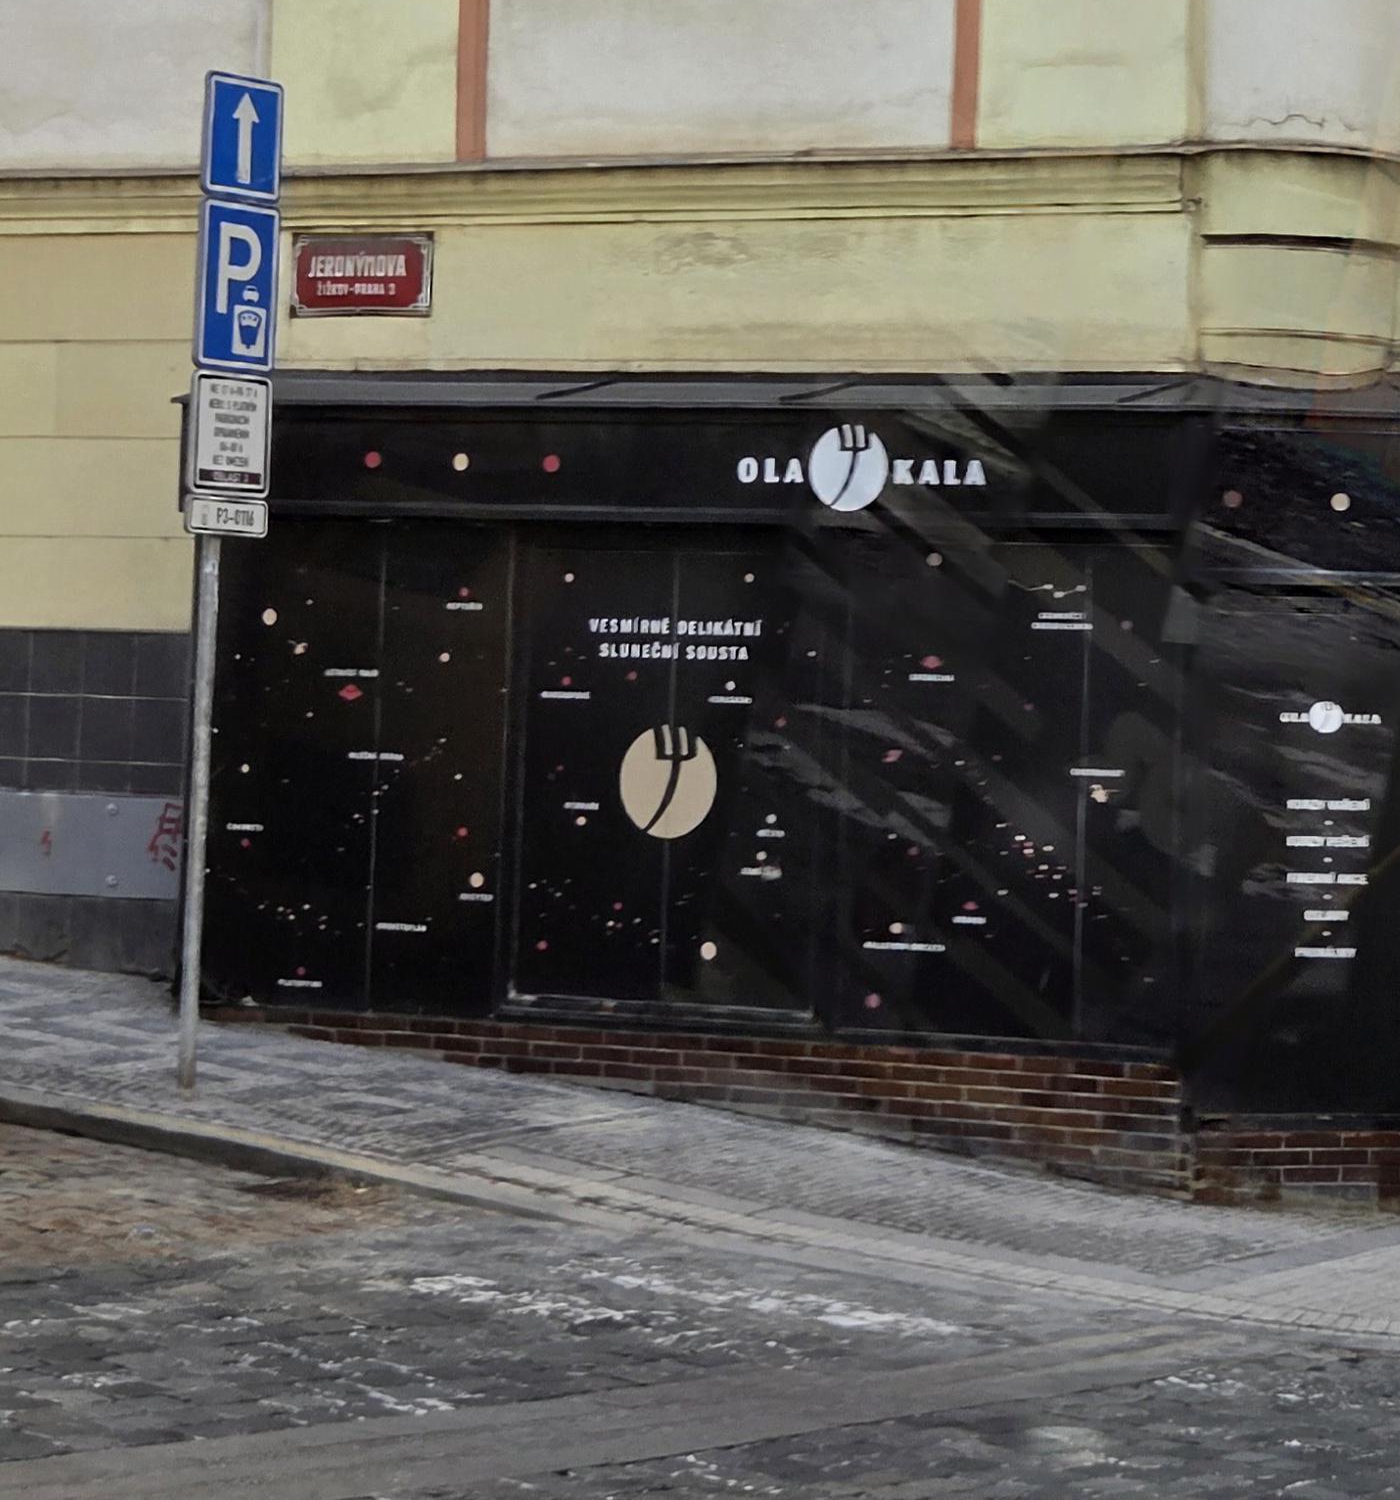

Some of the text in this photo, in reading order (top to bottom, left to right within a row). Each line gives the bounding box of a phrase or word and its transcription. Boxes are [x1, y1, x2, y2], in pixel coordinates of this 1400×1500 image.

[216, 221, 262, 315] P
[308, 250, 407, 278] JERONÝMOVA
[737, 457, 987, 486] OLA KALA
[588, 616, 762, 637] VESMÍRNÉ DELIKÁTNÍ
[598, 641, 749, 660] SLUNEČNÍ SOUSTA
